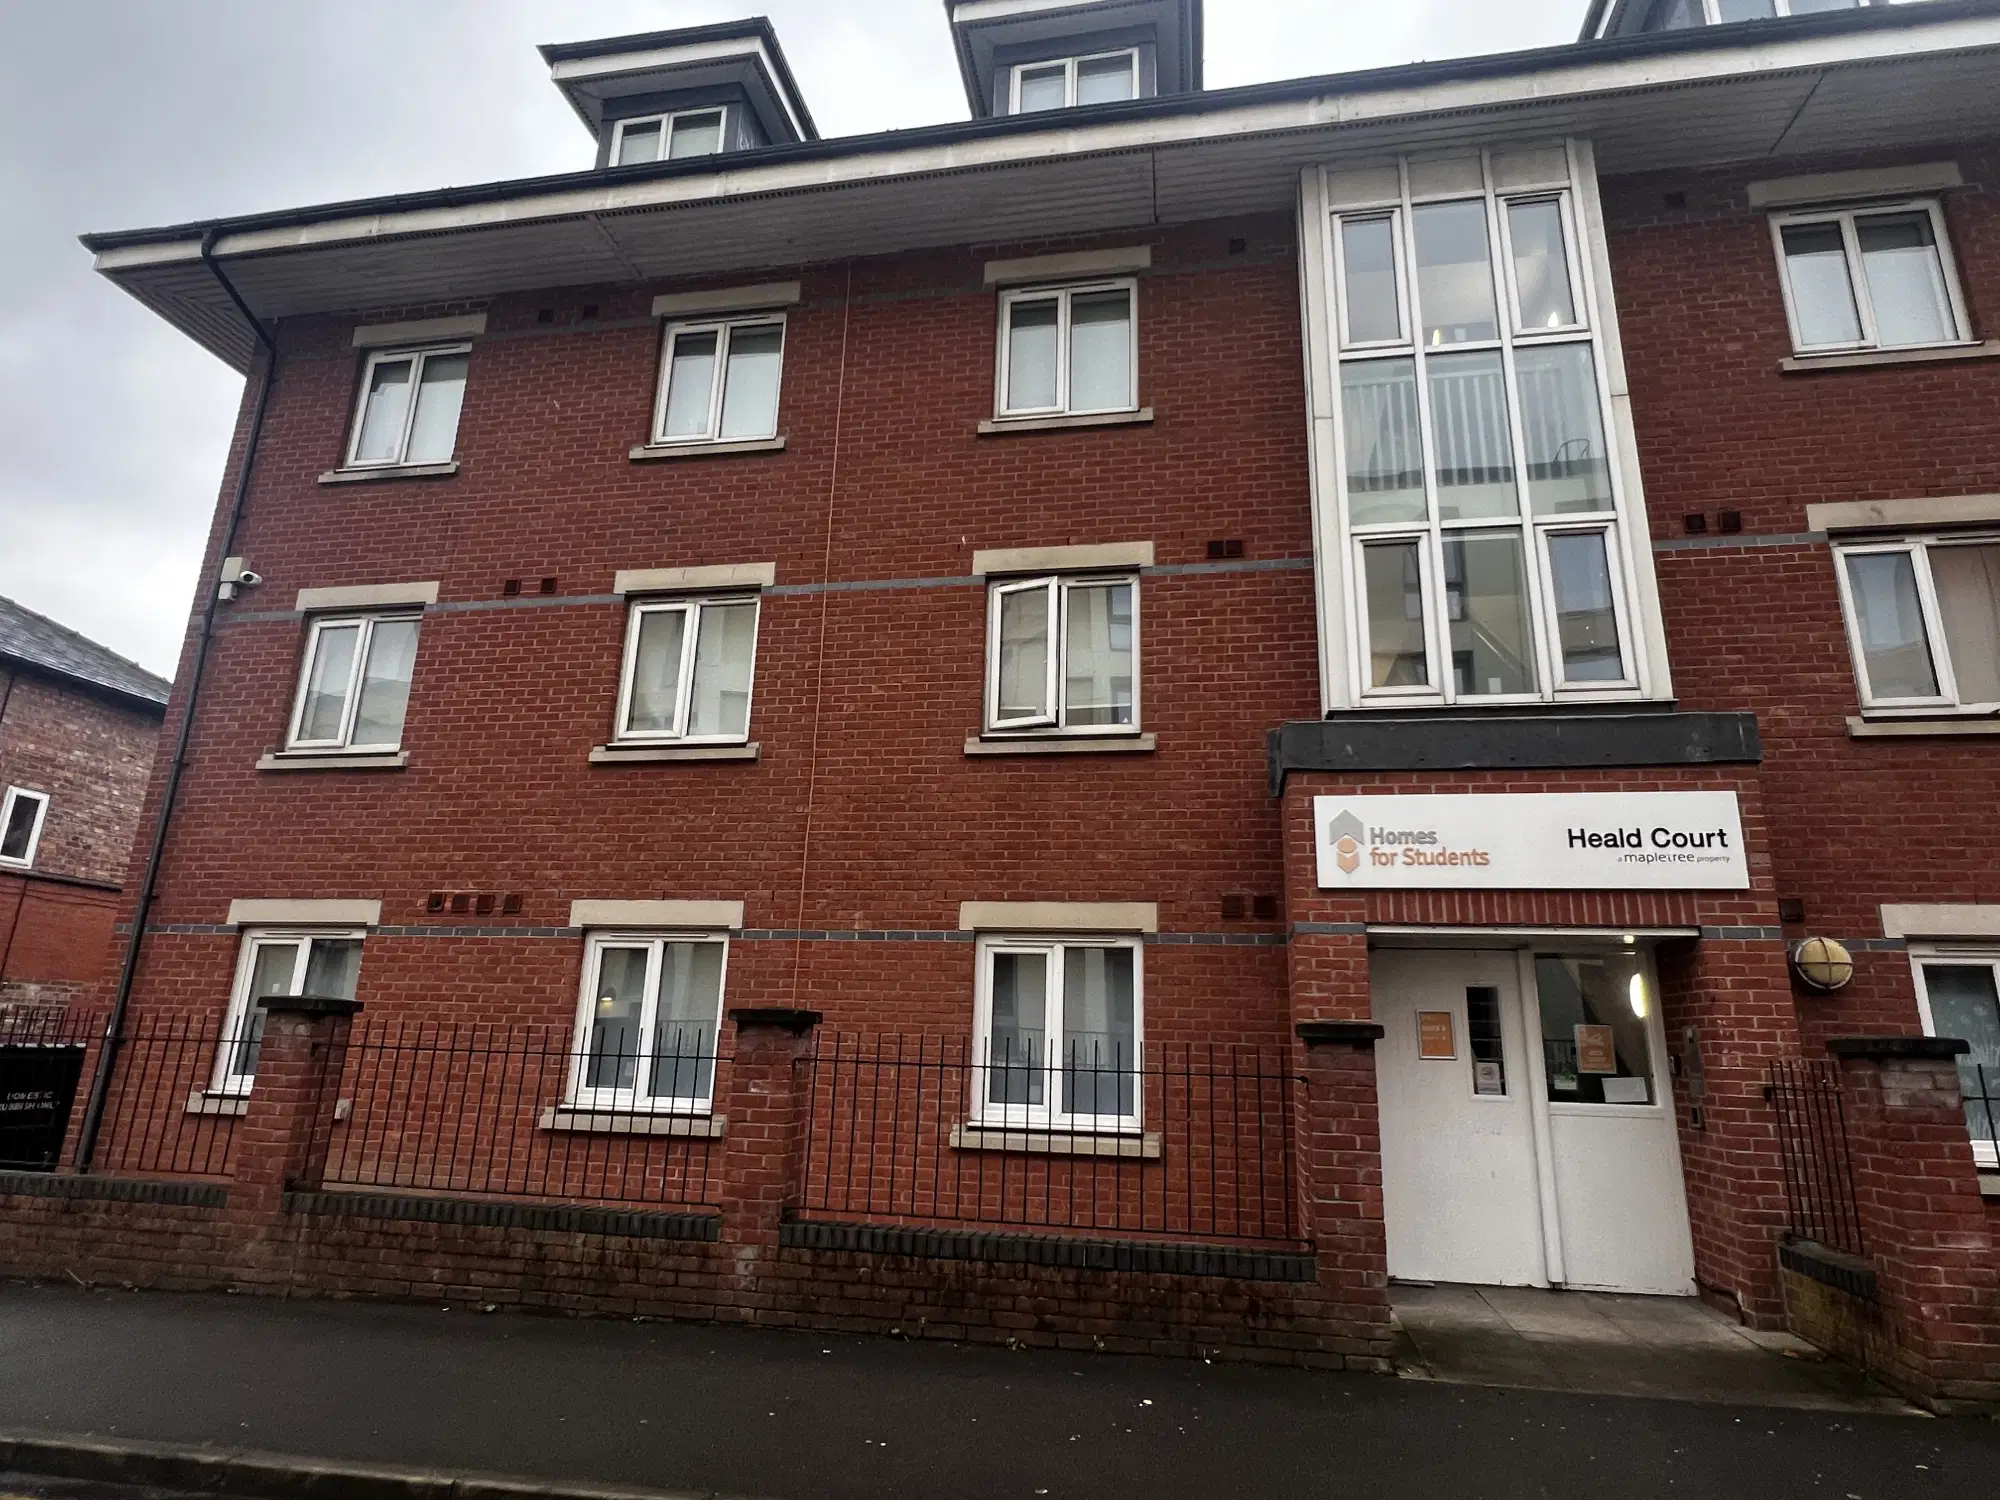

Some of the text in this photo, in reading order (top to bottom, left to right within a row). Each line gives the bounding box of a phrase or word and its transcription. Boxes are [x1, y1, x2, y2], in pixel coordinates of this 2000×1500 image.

[1369, 826, 1438, 845] Homes
[1567, 827, 1729, 848] Heald Court
[1369, 846, 1490, 866] for Students
[1624, 852, 1695, 865] mapletree
[1696, 855, 1731, 864] property
